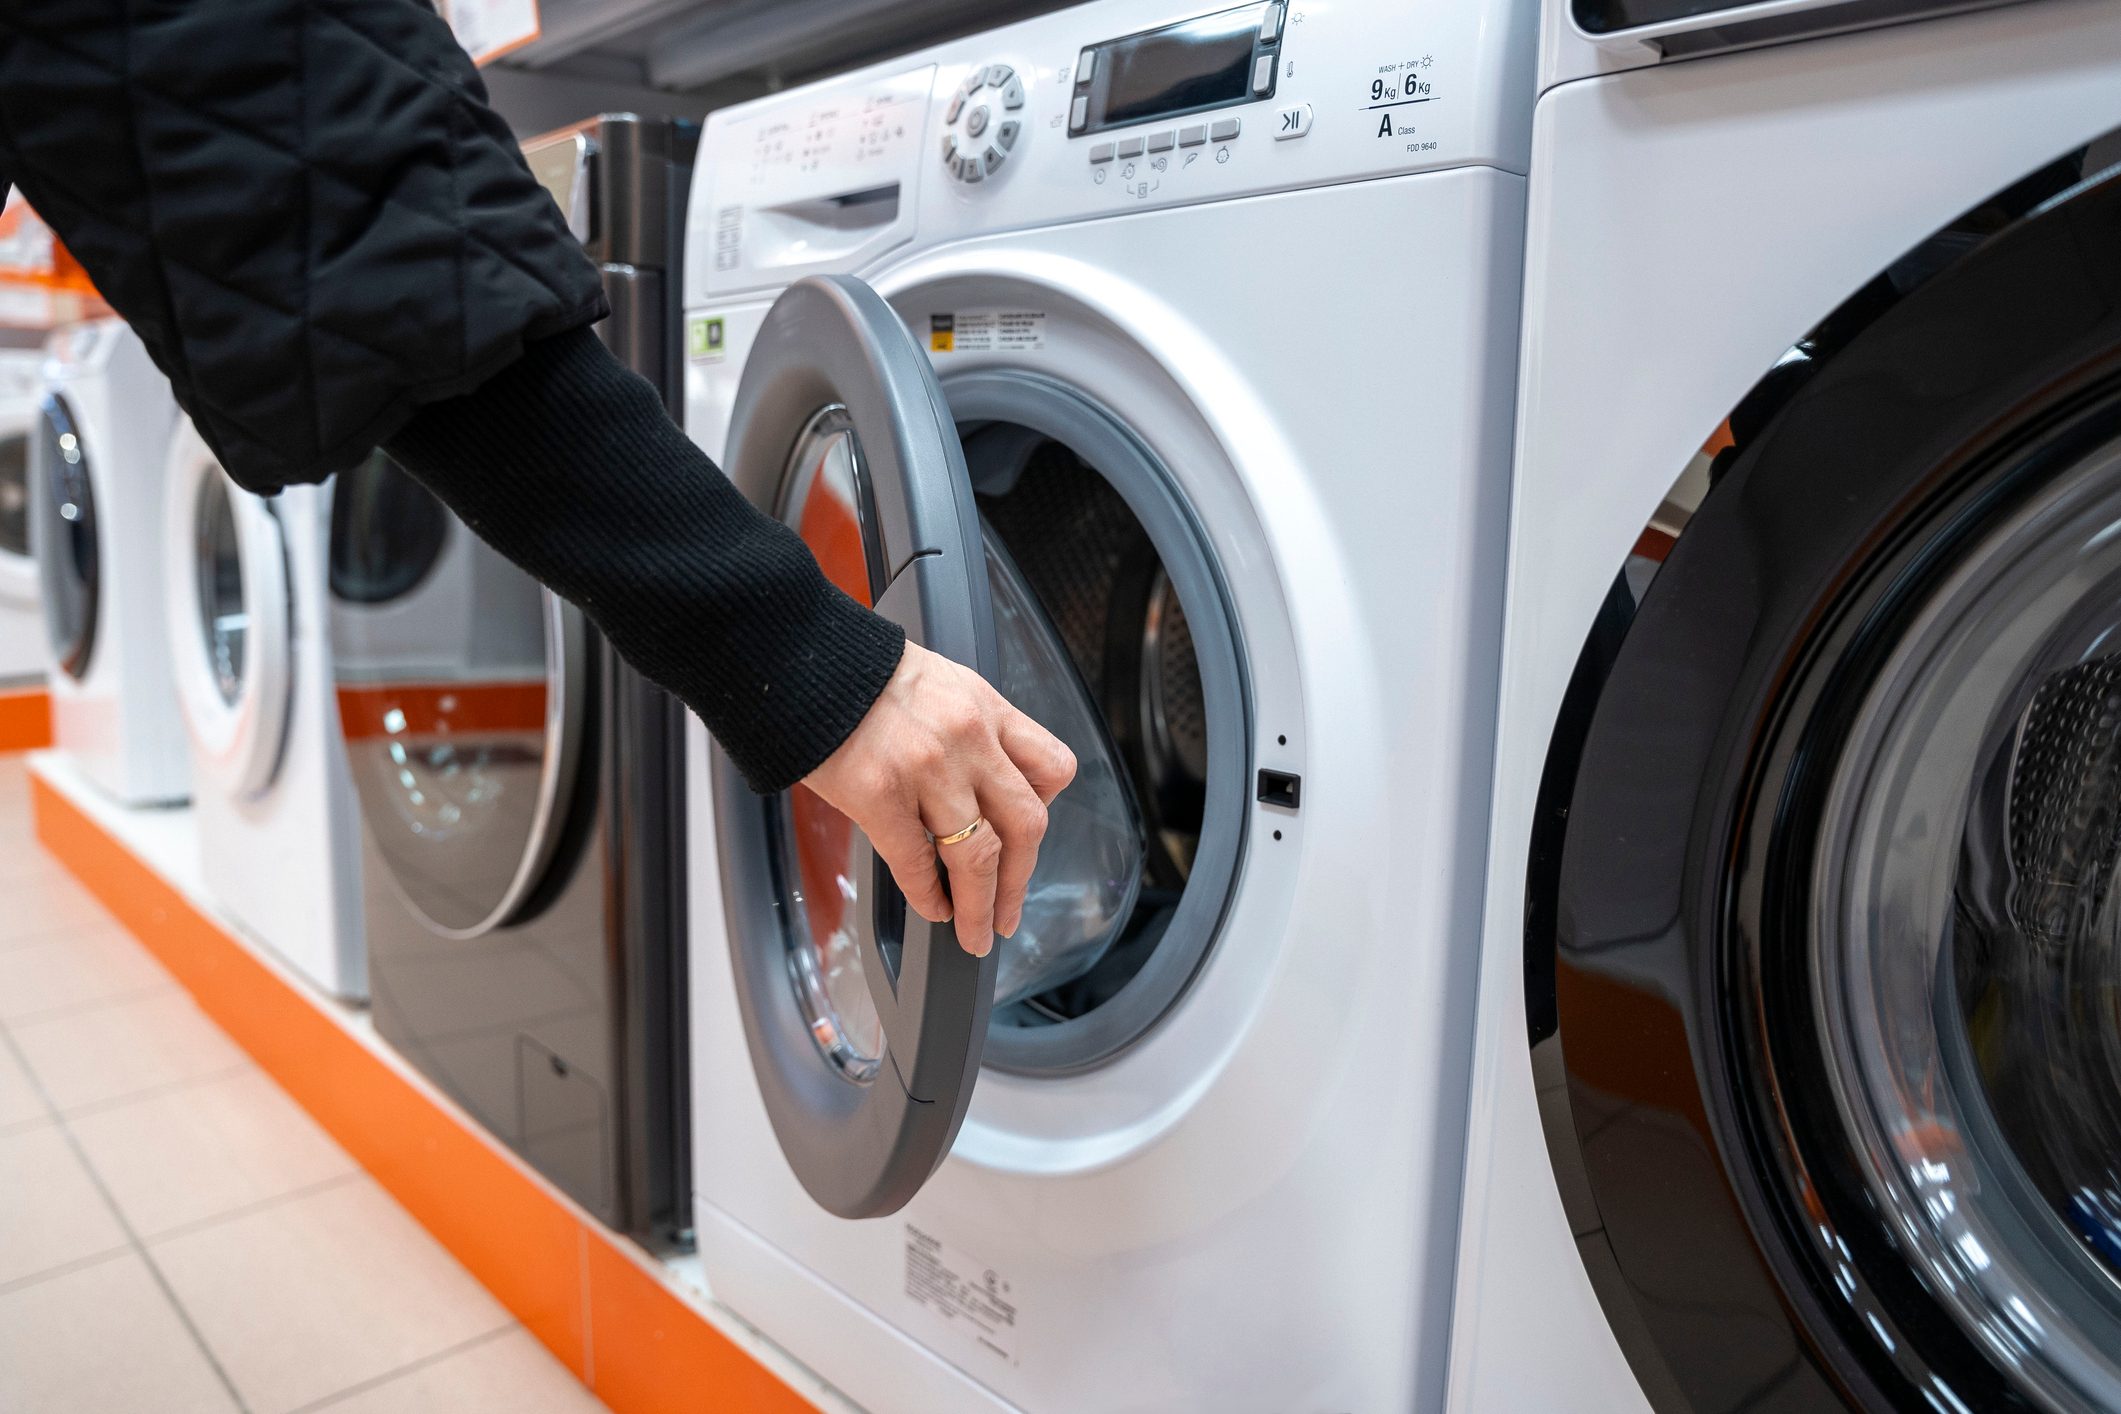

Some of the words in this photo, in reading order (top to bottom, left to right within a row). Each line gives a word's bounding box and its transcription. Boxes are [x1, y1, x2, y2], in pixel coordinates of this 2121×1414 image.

[1378, 64, 1396, 73] WASH
[1406, 60, 1419, 69] DRY
[1378, 113, 1392, 138] A
[1398, 127, 1415, 135] Class
[1407, 143, 1419, 152] FDD
[1421, 142, 1437, 151] 9640
